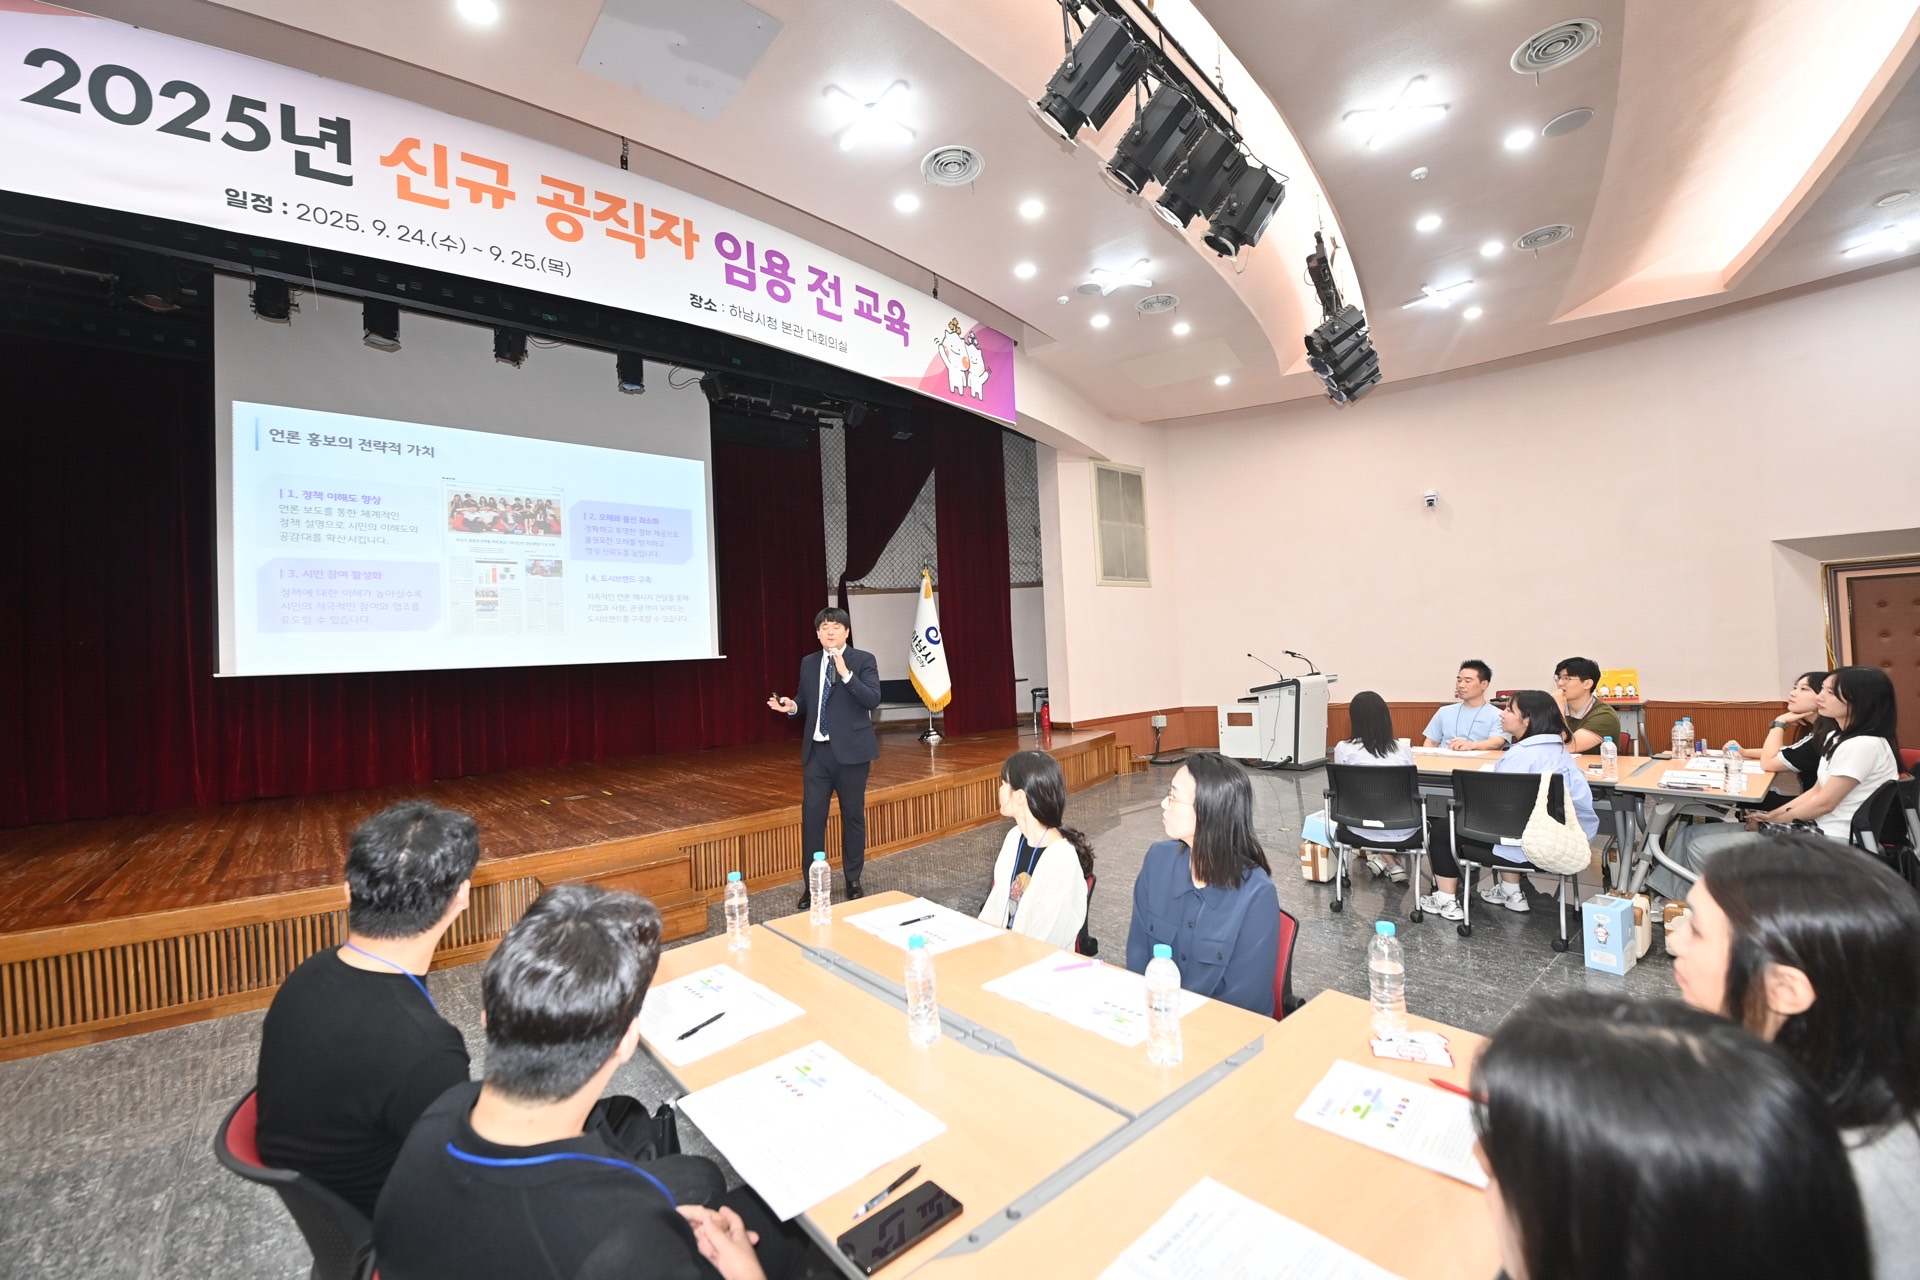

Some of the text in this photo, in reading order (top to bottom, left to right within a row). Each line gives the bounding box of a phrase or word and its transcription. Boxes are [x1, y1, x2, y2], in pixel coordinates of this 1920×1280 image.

[20, 47, 910, 347] 2025년 신규 공직자 임용 전 교육
[224, 187, 274, 214] 일정
[689, 292, 718, 313] 장소
[728, 301, 779, 331] 하남시청
[781, 319, 804, 339] 본관
[807, 325, 849, 353] 대회의실
[269, 428, 435, 458] 언론 홍보의 전략적 가치
[302, 490, 324, 501] 정책
[327, 492, 357, 503] 이해도
[361, 494, 382, 506] 향상
[278, 504, 400, 521] 언론 보도를 통한 체계적인
[599, 513, 621, 522] 오해와
[623, 515, 637, 524] 불신
[639, 516, 660, 525] 최소화
[279, 518, 419, 534] 정책 설명으로 시민의 이해도와
[584, 525, 680, 538] 정확하고 투명한 정보 제공으로
[279, 532, 389, 545] 공감대를 확산시킵니다.
[584, 536, 665, 548] 불필요한 오해를 방지하고
[602, 548, 629, 557] 신뢰도를
[302, 569, 324, 580] 시민
[327, 569, 349, 580] 참여
[352, 570, 383, 581] 활성화
[600, 575, 637, 584] 도시브랜드
[638, 575, 652, 584] 구축
[280, 588, 423, 599] 정책에 대한 이해가 높아질수록
[586, 593, 615, 602] 지속적인
[617, 593, 630, 602] 언론
[655, 594, 674, 602] 전달을
[280, 602, 420, 612] 시민의 적극적인 참여와 협조를
[587, 603, 609, 612] 기업과
[630, 604, 658, 612] 관광객이
[281, 615, 374, 625] 유도할 수 있습니다.
[587, 615, 629, 623] 도시브랜드를
[631, 615, 652, 624] 구축할
[654, 615, 661, 623] 수
